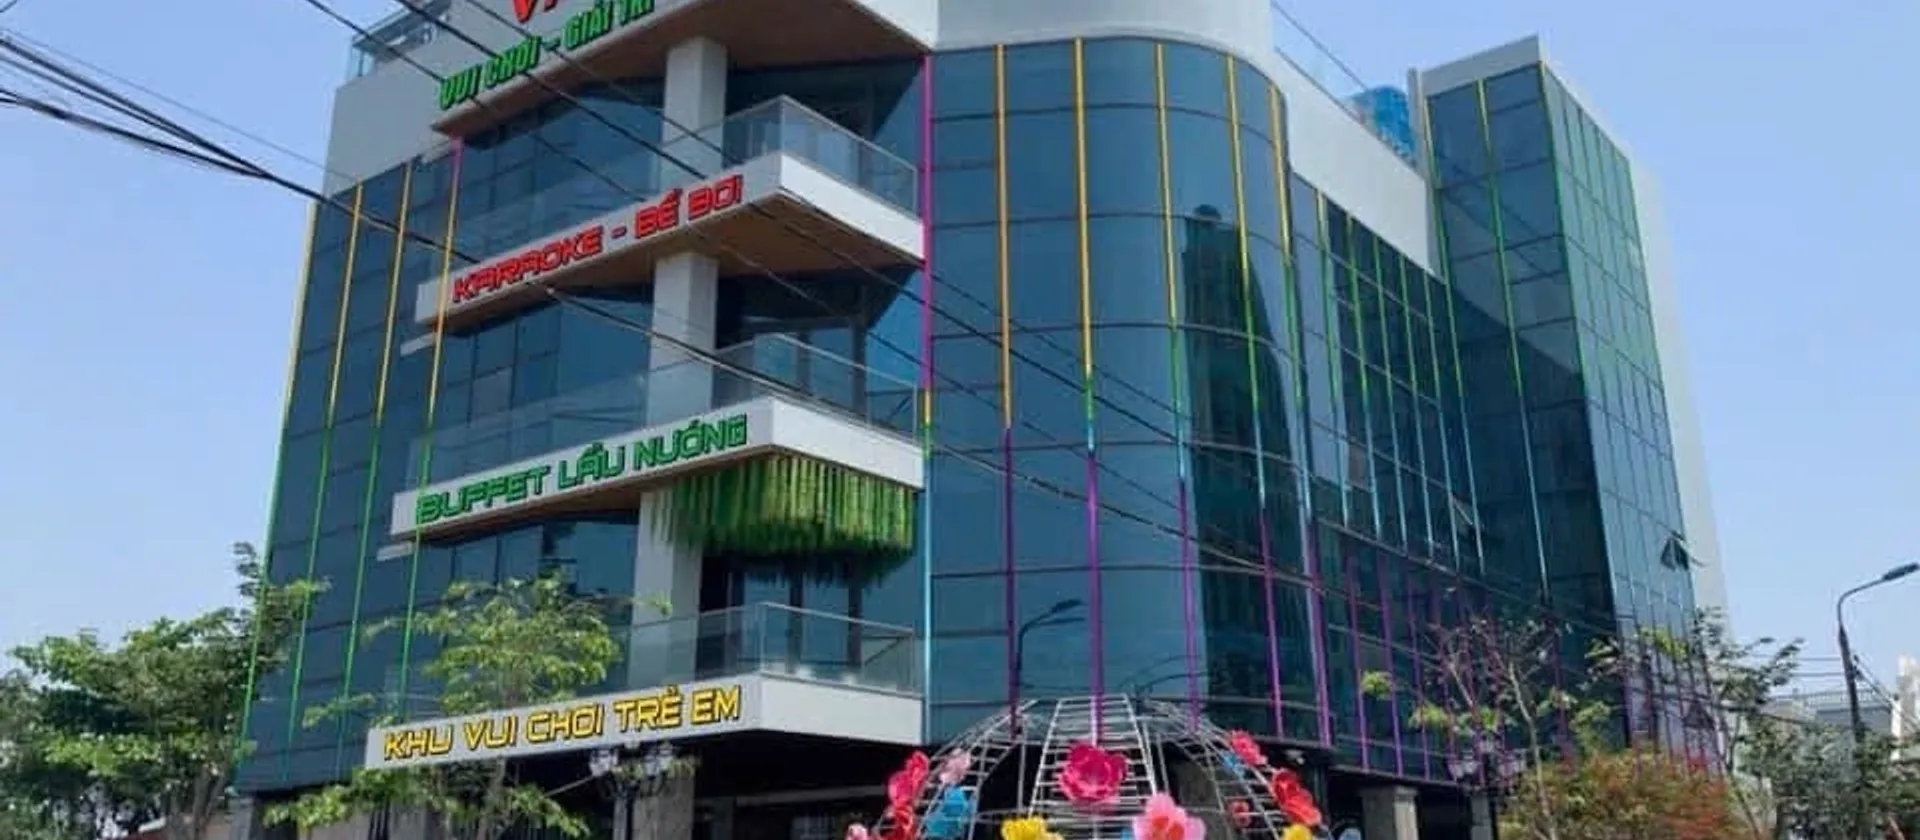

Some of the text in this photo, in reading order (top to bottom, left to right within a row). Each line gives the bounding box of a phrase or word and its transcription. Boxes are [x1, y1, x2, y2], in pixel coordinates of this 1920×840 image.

[453, 224, 603, 302] KARAOKE
[416, 465, 552, 524] BUFFET
[383, 726, 454, 761] KHU
[463, 714, 519, 750] VUI
[613, 684, 683, 734] TRẺ
[691, 683, 742, 724] EM
